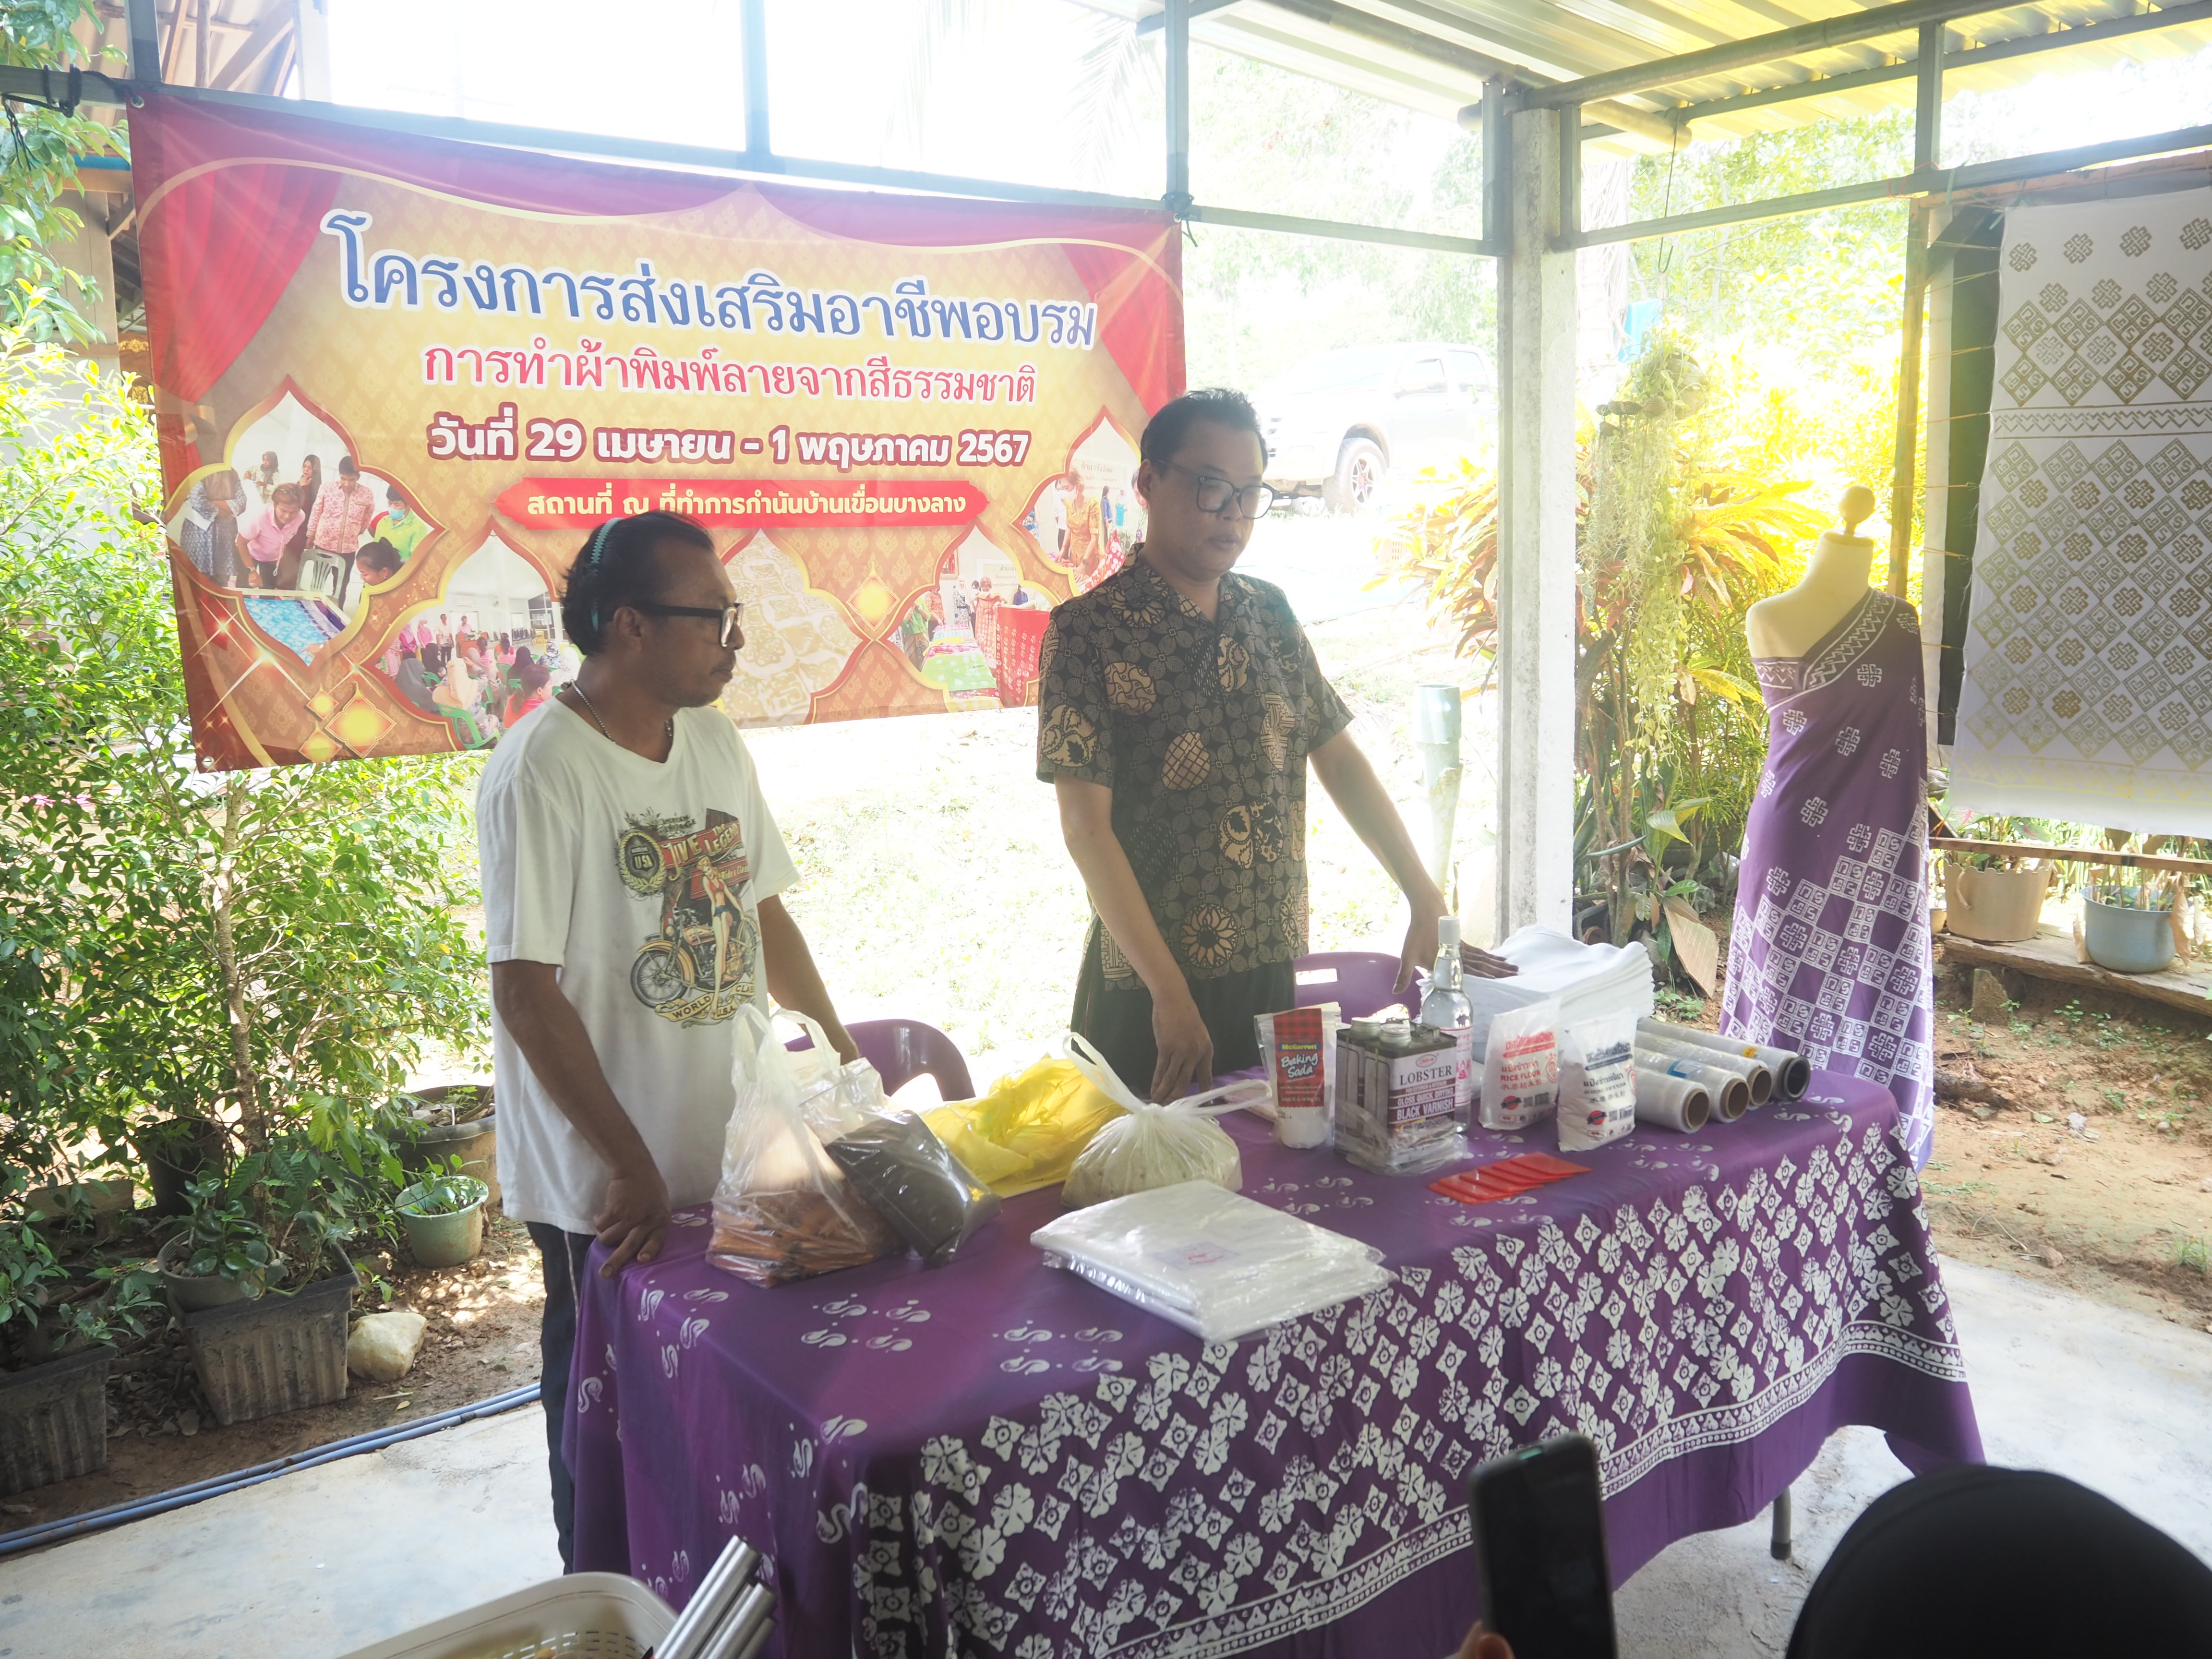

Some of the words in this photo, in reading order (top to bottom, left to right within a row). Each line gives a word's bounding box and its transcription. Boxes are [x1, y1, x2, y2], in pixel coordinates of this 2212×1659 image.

[325, 214, 1096, 346] โครงการส่งเสริมอาชีพอบรม
[425, 337, 1037, 403] การทำผ้าพิมพ์ลายจากสีธรรมชาติ
[430, 406, 515, 457] วันที่
[529, 422, 582, 457] 29
[597, 430, 731, 459] เมษายน
[772, 429, 787, 460] 1
[800, 433, 950, 469] พฤษภาคม
[959, 433, 1030, 463] 2567
[528, 482, 613, 515] สถานที่
[623, 497, 649, 515] ณ
[659, 482, 967, 516] ที่ทำการกำนันบ้านเขื่อนบางลาง
[634, 854, 653, 869] USA
[672, 995, 711, 1019] WORLD
[1280, 1053, 1318, 1068] Baking
[1287, 1064, 1313, 1078] Soda
[1400, 1065, 1452, 1086] LOBSTER
[1520, 1069, 1541, 1080] FLOUR
[1397, 1095, 1415, 1106] GLOSS
[1417, 1092, 1433, 1102] QUICK
[1434, 1087, 1454, 1099] DRYING
[1396, 1105, 1420, 1121] BLACK
[1423, 1098, 1454, 1115] VARNISH
